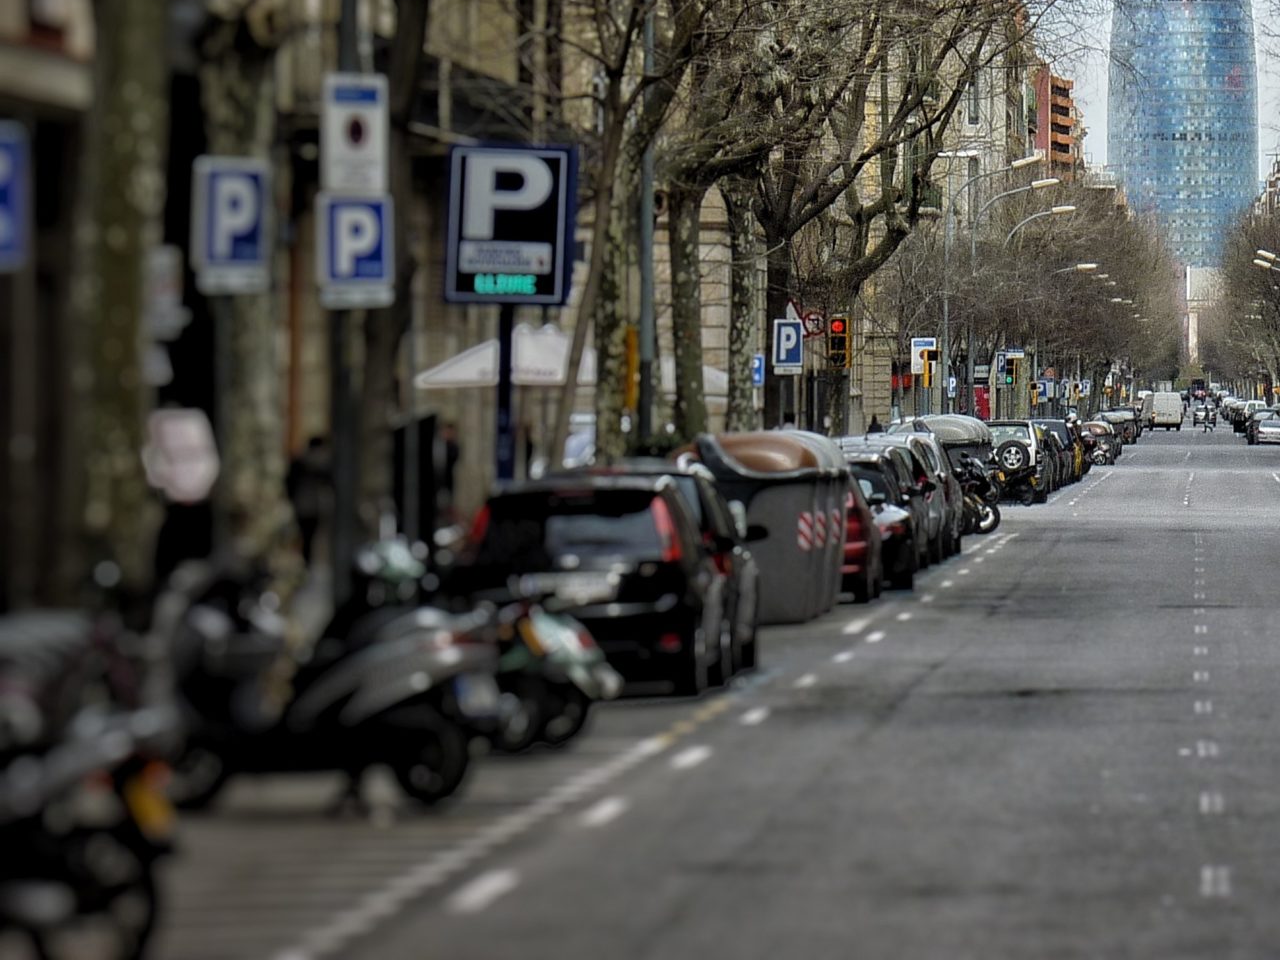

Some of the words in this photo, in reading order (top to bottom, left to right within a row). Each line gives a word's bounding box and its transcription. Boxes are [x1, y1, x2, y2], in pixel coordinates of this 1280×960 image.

[213, 176, 258, 257] P
[462, 153, 553, 240] P
[334, 205, 379, 277] P
[780, 326, 797, 360] P
[998, 355, 1005, 371] P
[949, 377, 956, 392] P
